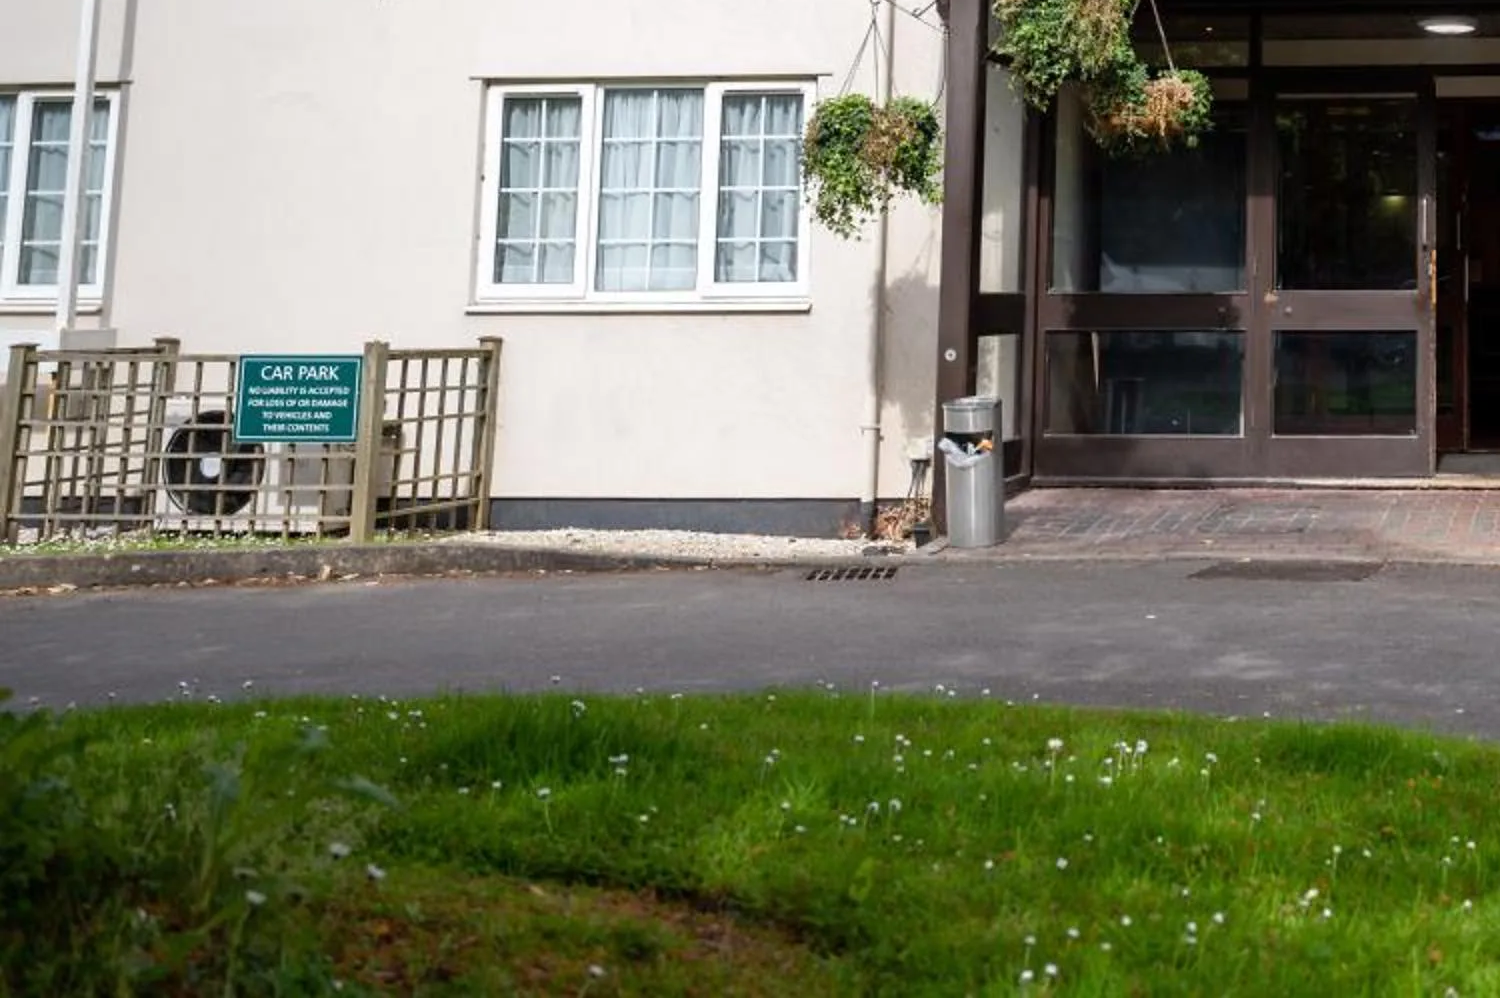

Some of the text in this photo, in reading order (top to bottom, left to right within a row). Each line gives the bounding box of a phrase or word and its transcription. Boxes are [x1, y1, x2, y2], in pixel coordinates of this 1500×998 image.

[261, 365, 340, 381] CAR PARK
[261, 386, 298, 395] LIABILITY
[299, 386, 307, 395] IS
[307, 386, 351, 395] ACCEPTED
[248, 399, 348, 407] FOR LOSS OF OR DAMAGE
[262, 411, 333, 420] TO VEHICLES AND
[262, 423, 330, 432] THEIR CONTENTS
